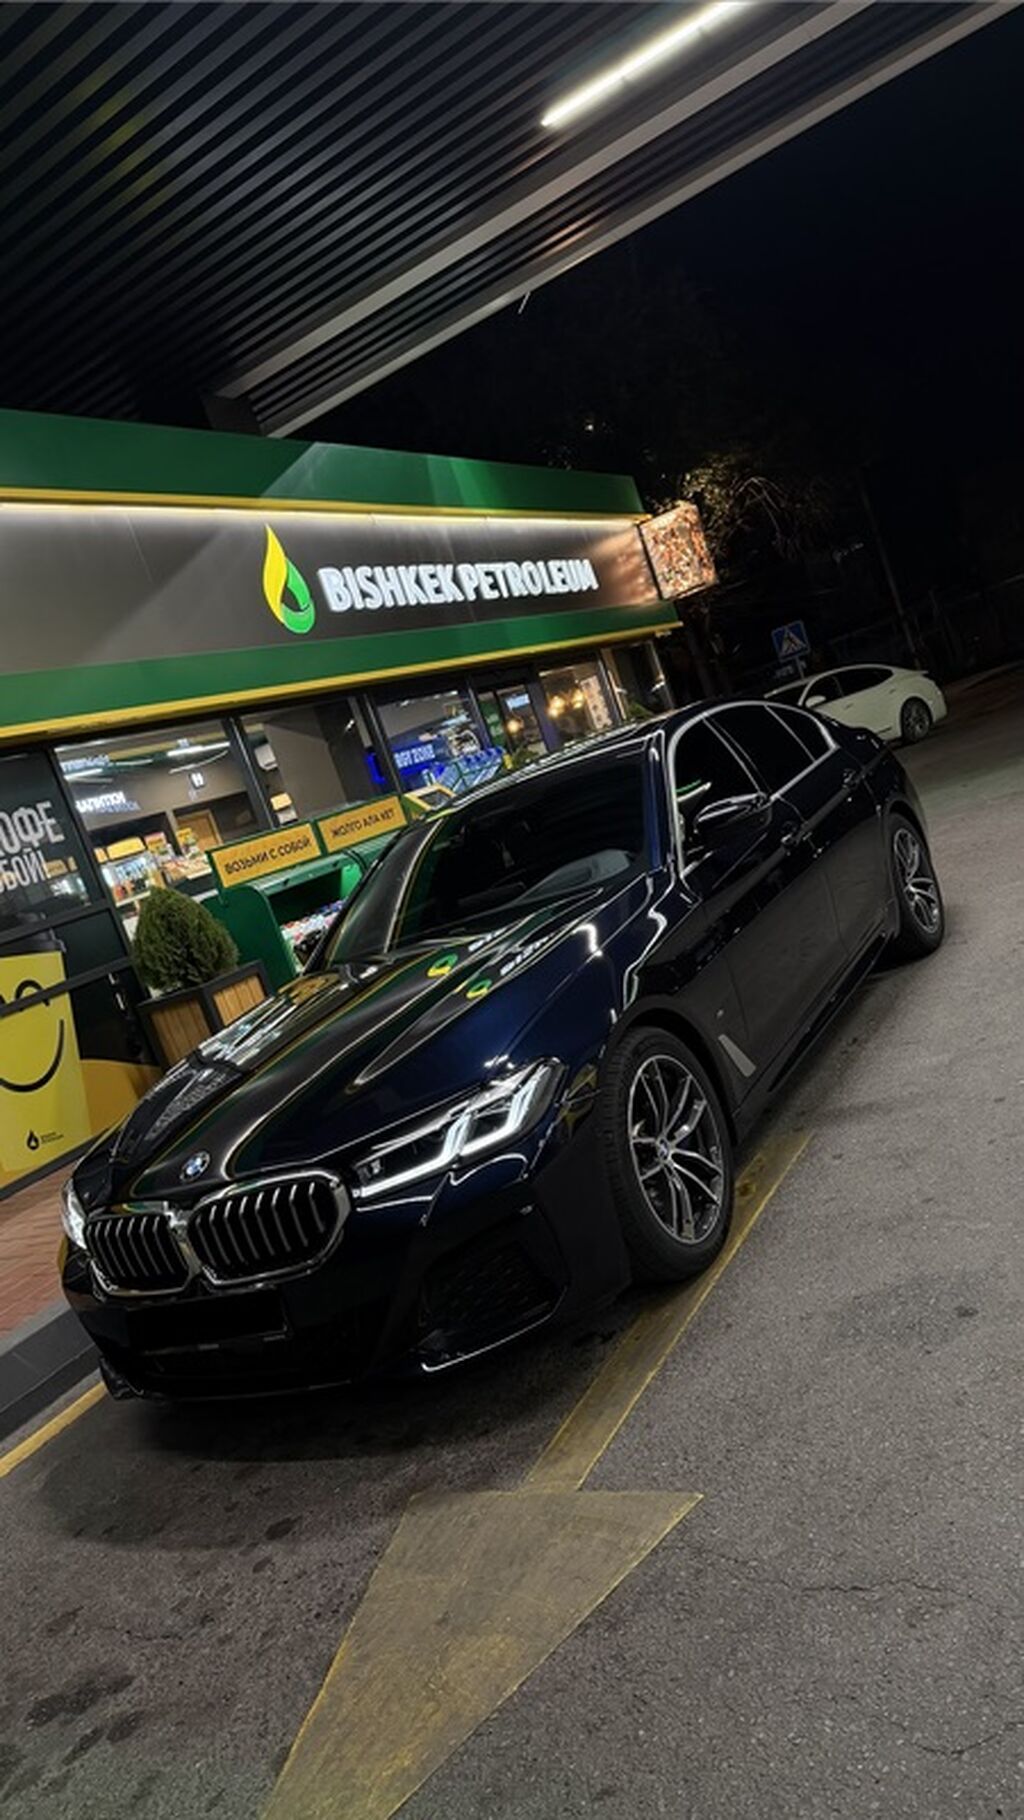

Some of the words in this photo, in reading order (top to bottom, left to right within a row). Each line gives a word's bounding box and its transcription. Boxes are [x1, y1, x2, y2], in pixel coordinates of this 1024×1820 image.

[317, 564, 465, 613] BISHKEK
[456, 558, 599, 602] PETROLEUM
[0, 801, 65, 857] ОФЕ
[0, 847, 51, 893] БОЙ!
[224, 851, 269, 875] ВОЗЬМИ
[269, 848, 278, 860] С
[278, 835, 311, 856] СОБОЙ
